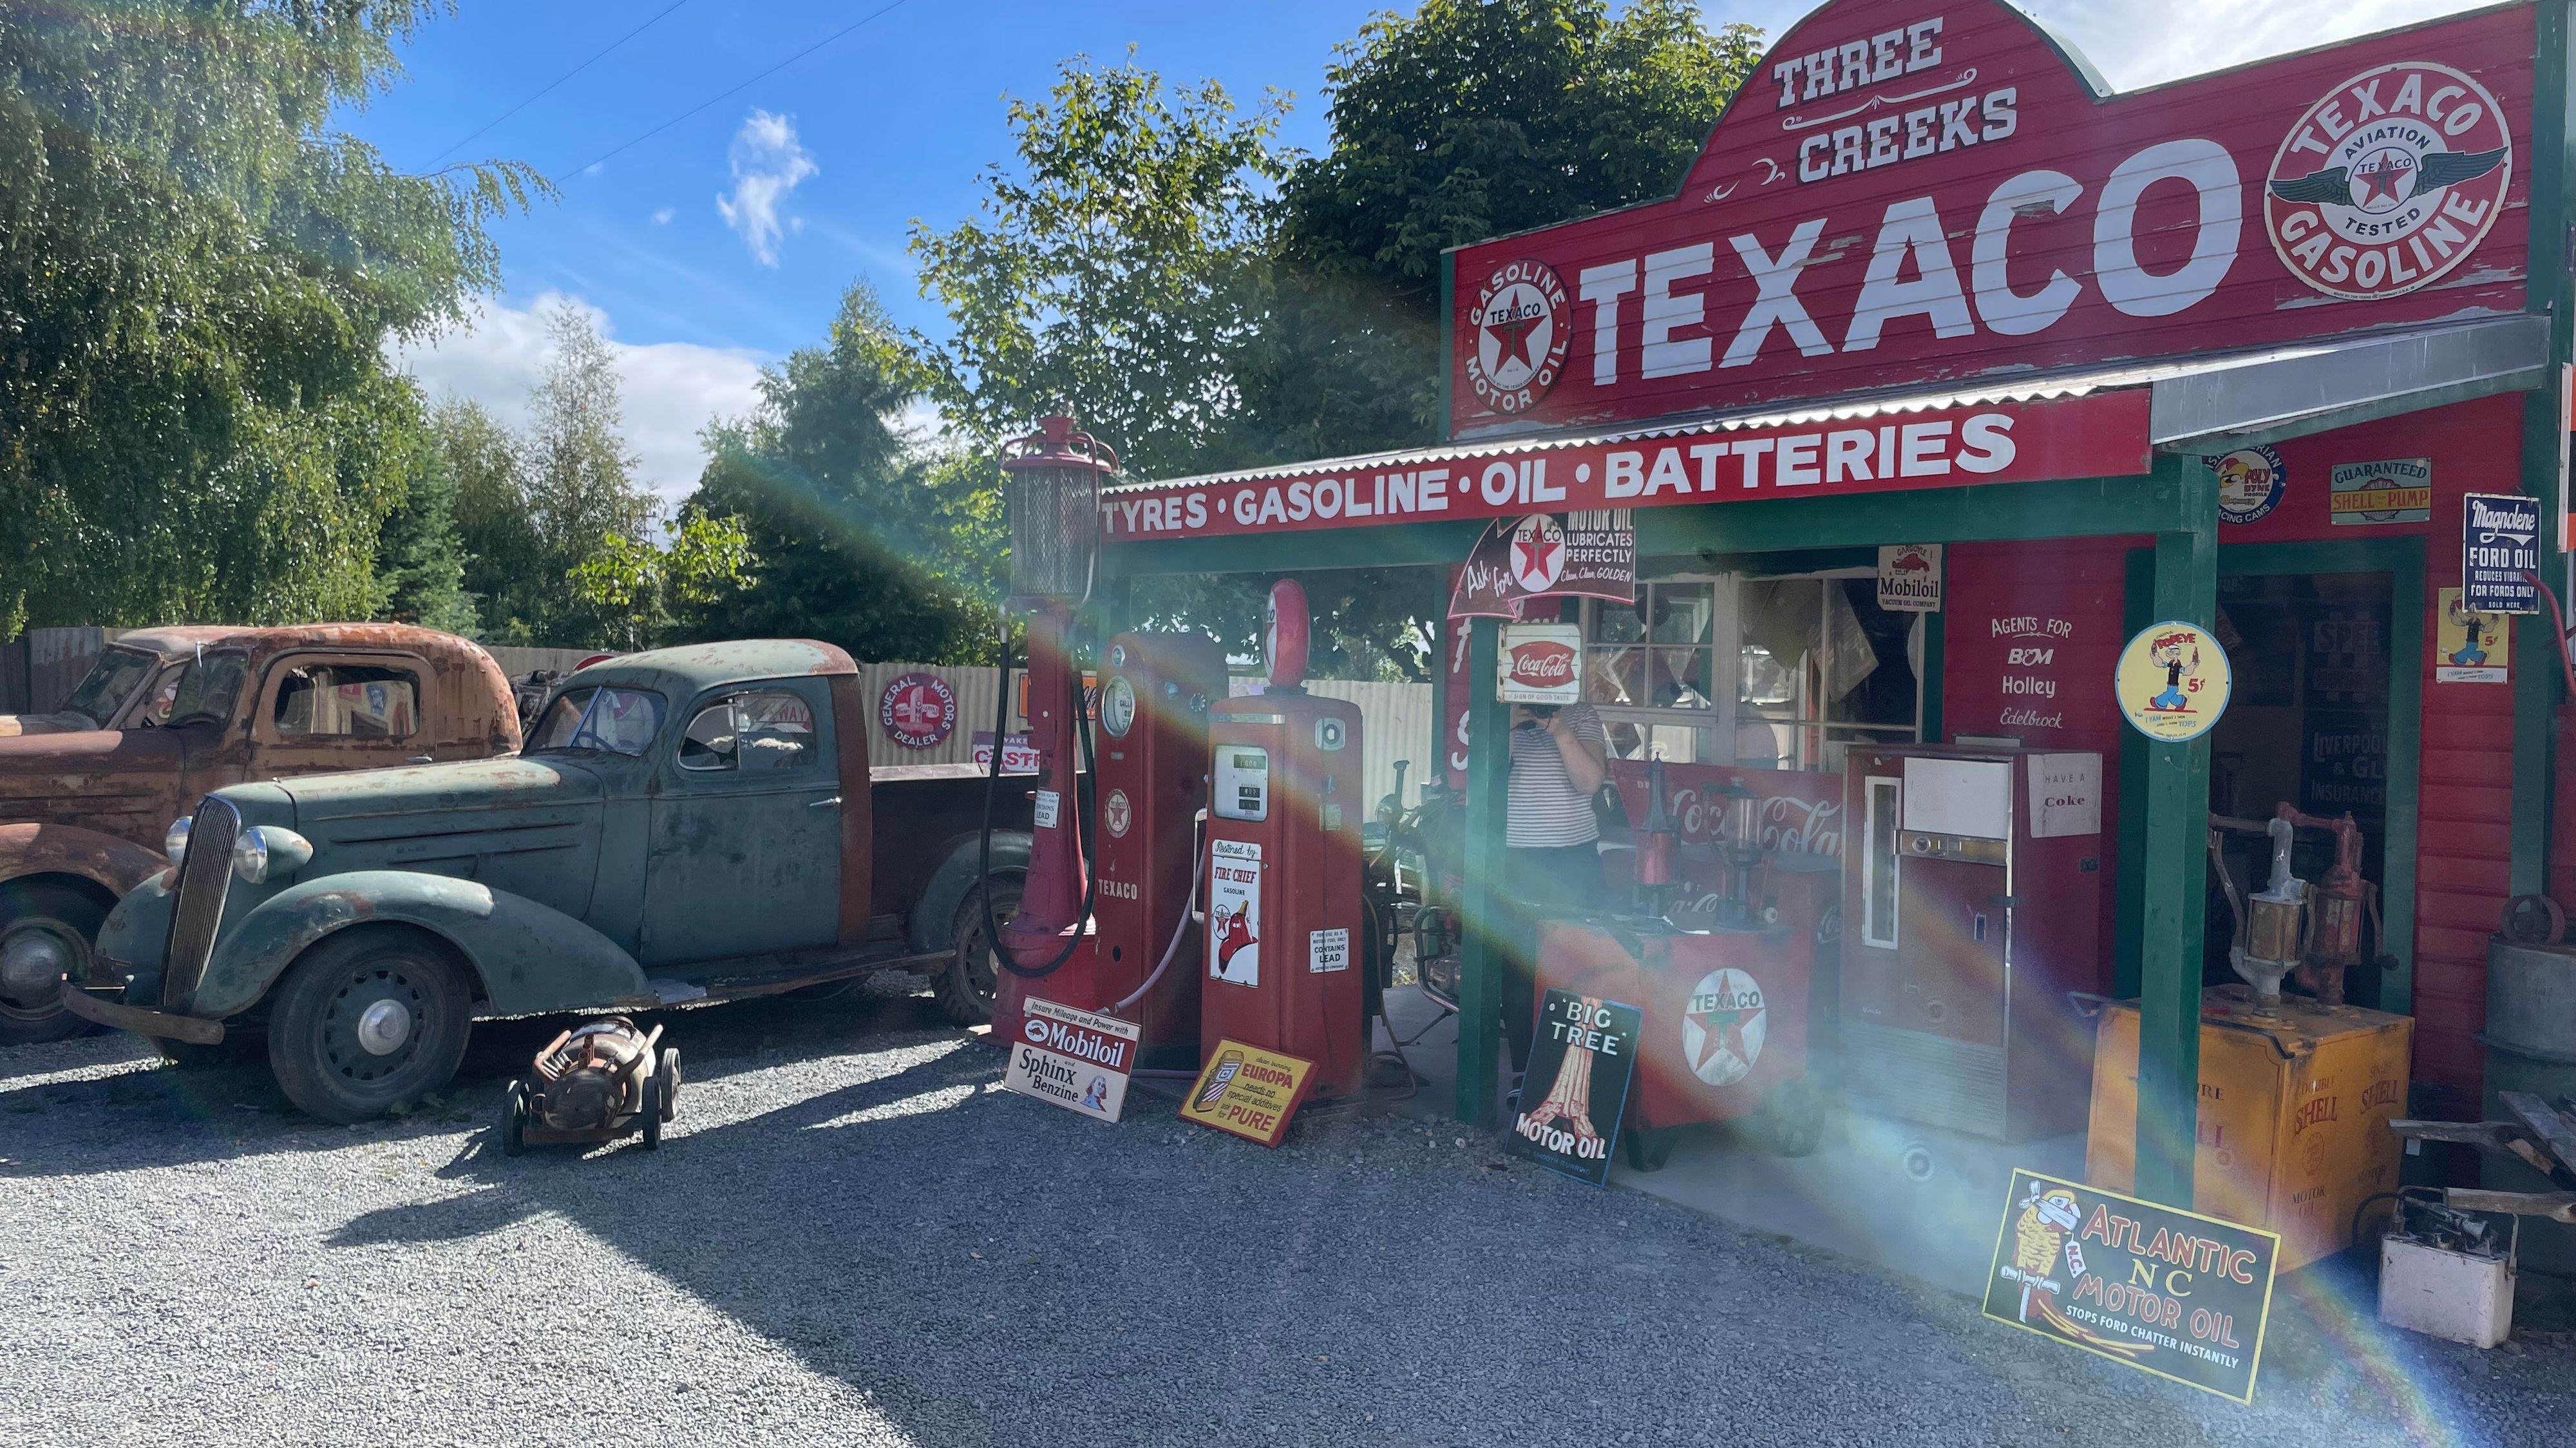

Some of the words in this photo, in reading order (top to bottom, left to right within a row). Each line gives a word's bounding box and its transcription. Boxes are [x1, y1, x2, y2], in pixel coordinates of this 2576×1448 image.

[1772, 17, 1944, 108] THREE
[2290, 74, 2482, 155] TEXACO
[1799, 86, 2017, 183] CREEKS
[2344, 126, 2430, 160] AVIATION
[2360, 158, 2412, 173] TEXACO
[2345, 207, 2421, 236] TESTED
[2281, 191, 2489, 289] GASOLINE
[1580, 139, 2242, 386] TEXACO
[1471, 263, 1566, 326] GASOLINE
[1490, 303, 1541, 324] TEXACO
[1539, 341, 1567, 386] OIL
[1466, 356, 1533, 411] MOTOR
[1102, 493, 1208, 534] TYRES
[1233, 468, 1449, 526] GASOLINE
[1481, 457, 1566, 506] OIL
[1604, 412, 2017, 499] BATTERIES
[2334, 462, 2427, 484] GUARANTEED
[2333, 492, 2374, 510] SHELL
[2387, 490, 2428, 508] PUMP
[1567, 508, 1609, 531] MOTOR
[1613, 508, 1633, 529] OIL
[2245, 504, 2270, 521] CAMS
[2472, 500, 2535, 540] Magnolene
[1518, 529, 1561, 543] TEXACO
[1567, 533, 1633, 547] LUBRICATES
[1566, 549, 1633, 564] PERFECTLY
[2469, 548, 2509, 567] FORD
[2514, 549, 2535, 569] OIL
[1466, 560, 1491, 599] Ask
[1493, 566, 1513, 598] for
[1597, 567, 1633, 582] GOLDEN
[2475, 571, 2502, 582] REDUCES
[1880, 577, 1938, 598] Mobiloil
[2471, 586, 2488, 596] FOR
[2490, 586, 2514, 598] FORDS
[2517, 586, 2535, 598] ONLY
[1992, 616, 2038, 638] AGENTS
[2047, 618, 2072, 638] FOR
[2155, 633, 2196, 649] POPEYE
[1517, 653, 1570, 677] Coca-Cola
[2007, 648, 2054, 667] B&M
[2002, 676, 2056, 698] Holley
[882, 676, 916, 726] GENERAL
[931, 680, 955, 730] MOTORS
[2000, 707, 2063, 729] Edelbrock
[894, 730, 938, 747] DEALER
[2045, 774, 2073, 783] HAVE
[2080, 774, 2085, 782] A
[2045, 795, 2085, 807] Coke
[1215, 841, 1244, 855] Restored
[1247, 846, 1256, 859] by
[1215, 867, 1231, 881] FIRE
[1233, 869, 1256, 884] CHIEF
[1098, 879, 1138, 900] TEXACO
[1224, 887, 1245, 895] GASOLINE
[1314, 944, 1345, 953] CONTAINS
[1320, 954, 1340, 962] LEAD
[1693, 991, 1760, 1012] TEXACO
[1031, 1001, 1052, 1014] Insure
[1053, 1007, 1078, 1022] Mileage
[1079, 1016, 1092, 1025] and
[1093, 1019, 1113, 1031] Power
[1115, 1025, 1129, 1035] with
[1047, 1022, 1125, 1068] Mobiloil
[1019, 1048, 1077, 1085] Sphinx
[1242, 1063, 1293, 1089] EUROPA
[1032, 1075, 1079, 1103] Benzine
[1244, 1083, 1266, 1095] needs
[1265, 1089, 1276, 1098] no
[2360, 1080, 2398, 1114] SHELL
[1227, 1090, 1251, 1105] special
[1251, 1097, 1282, 1112] additives
[2295, 1096, 2337, 1136] SHELL
[1516, 1112, 1575, 1155] MOTOR
[1578, 1136, 1605, 1159] OIL
[2293, 1185, 2325, 1205] MOTOR
[2081, 1203, 2256, 1284] ATLANTIC
[2072, 1273, 2182, 1329] MOTOR
[2189, 1308, 2240, 1349] OIL
[2065, 1304, 2098, 1324] STOPS
[2099, 1315, 2128, 1333] FORD
[2130, 1325, 2177, 1350] CHATTER
[2179, 1340, 2240, 1369] INSTANTLY
